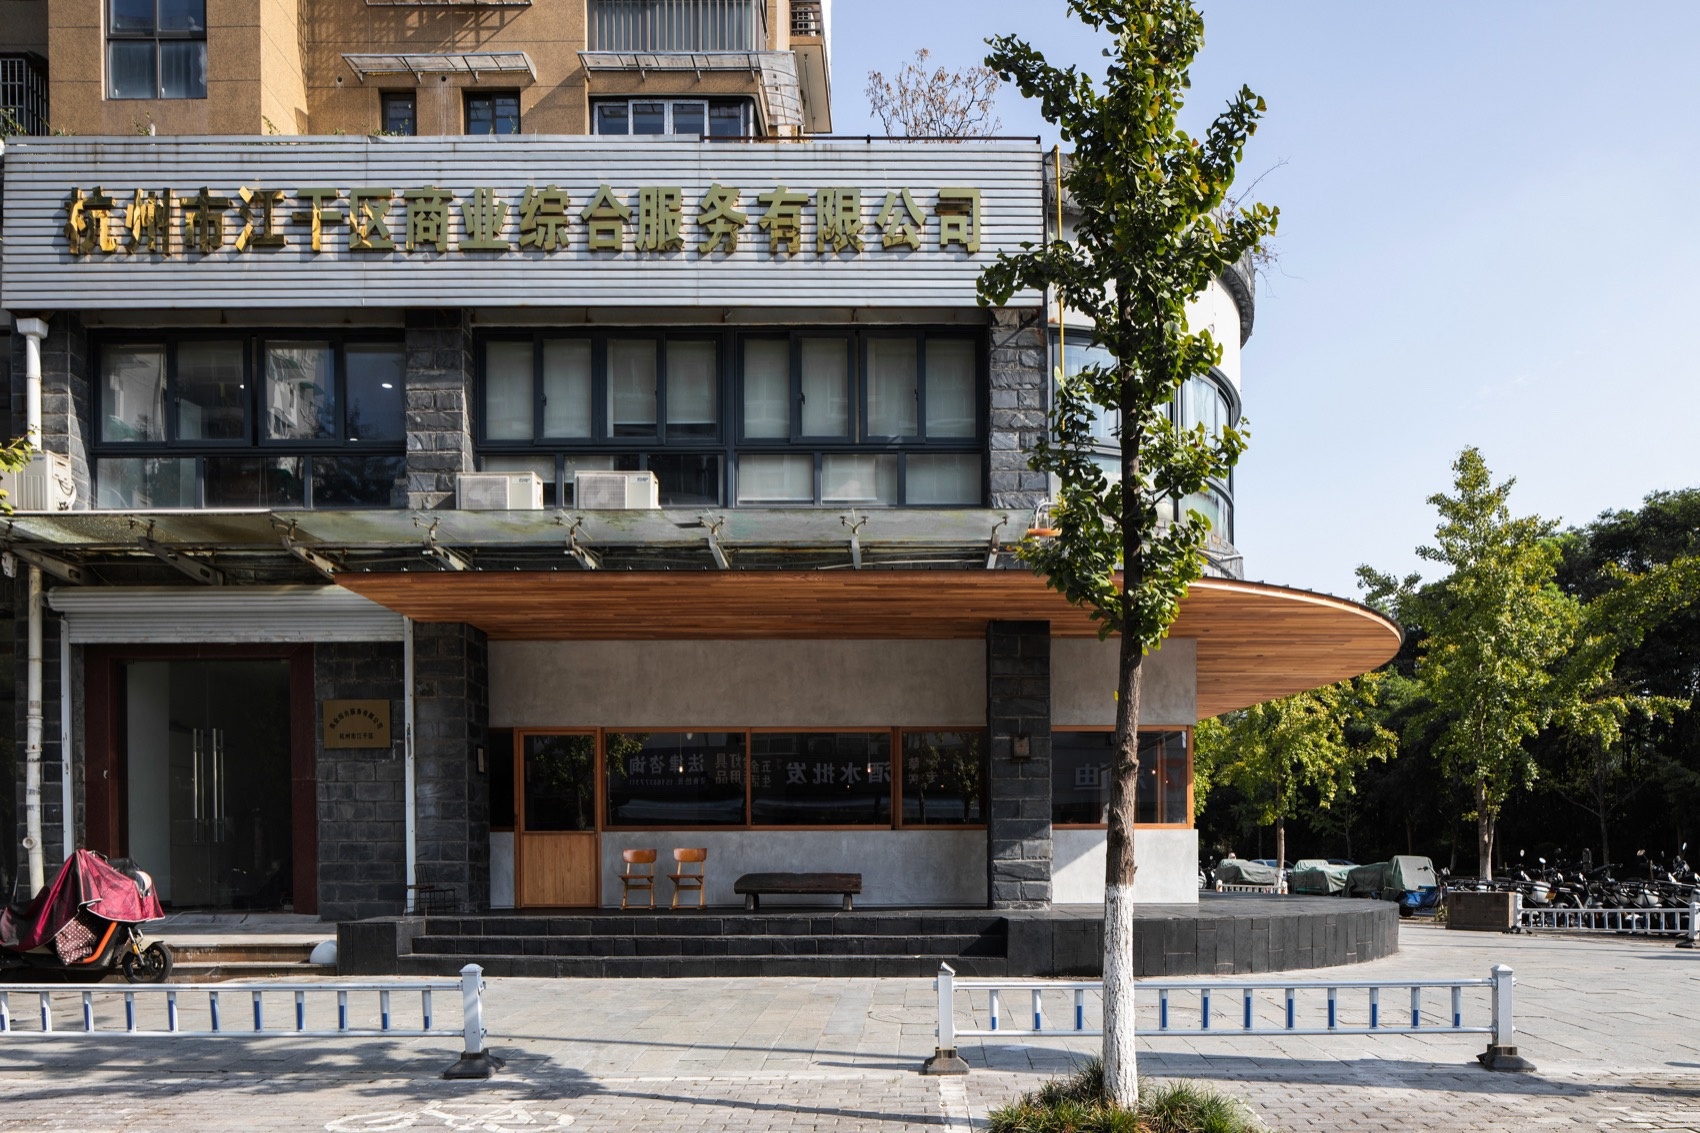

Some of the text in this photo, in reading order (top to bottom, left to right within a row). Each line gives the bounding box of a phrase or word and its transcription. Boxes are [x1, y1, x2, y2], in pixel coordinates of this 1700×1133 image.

[64, 185, 981, 256] 杭州市江干区商业综合服务有限公司
